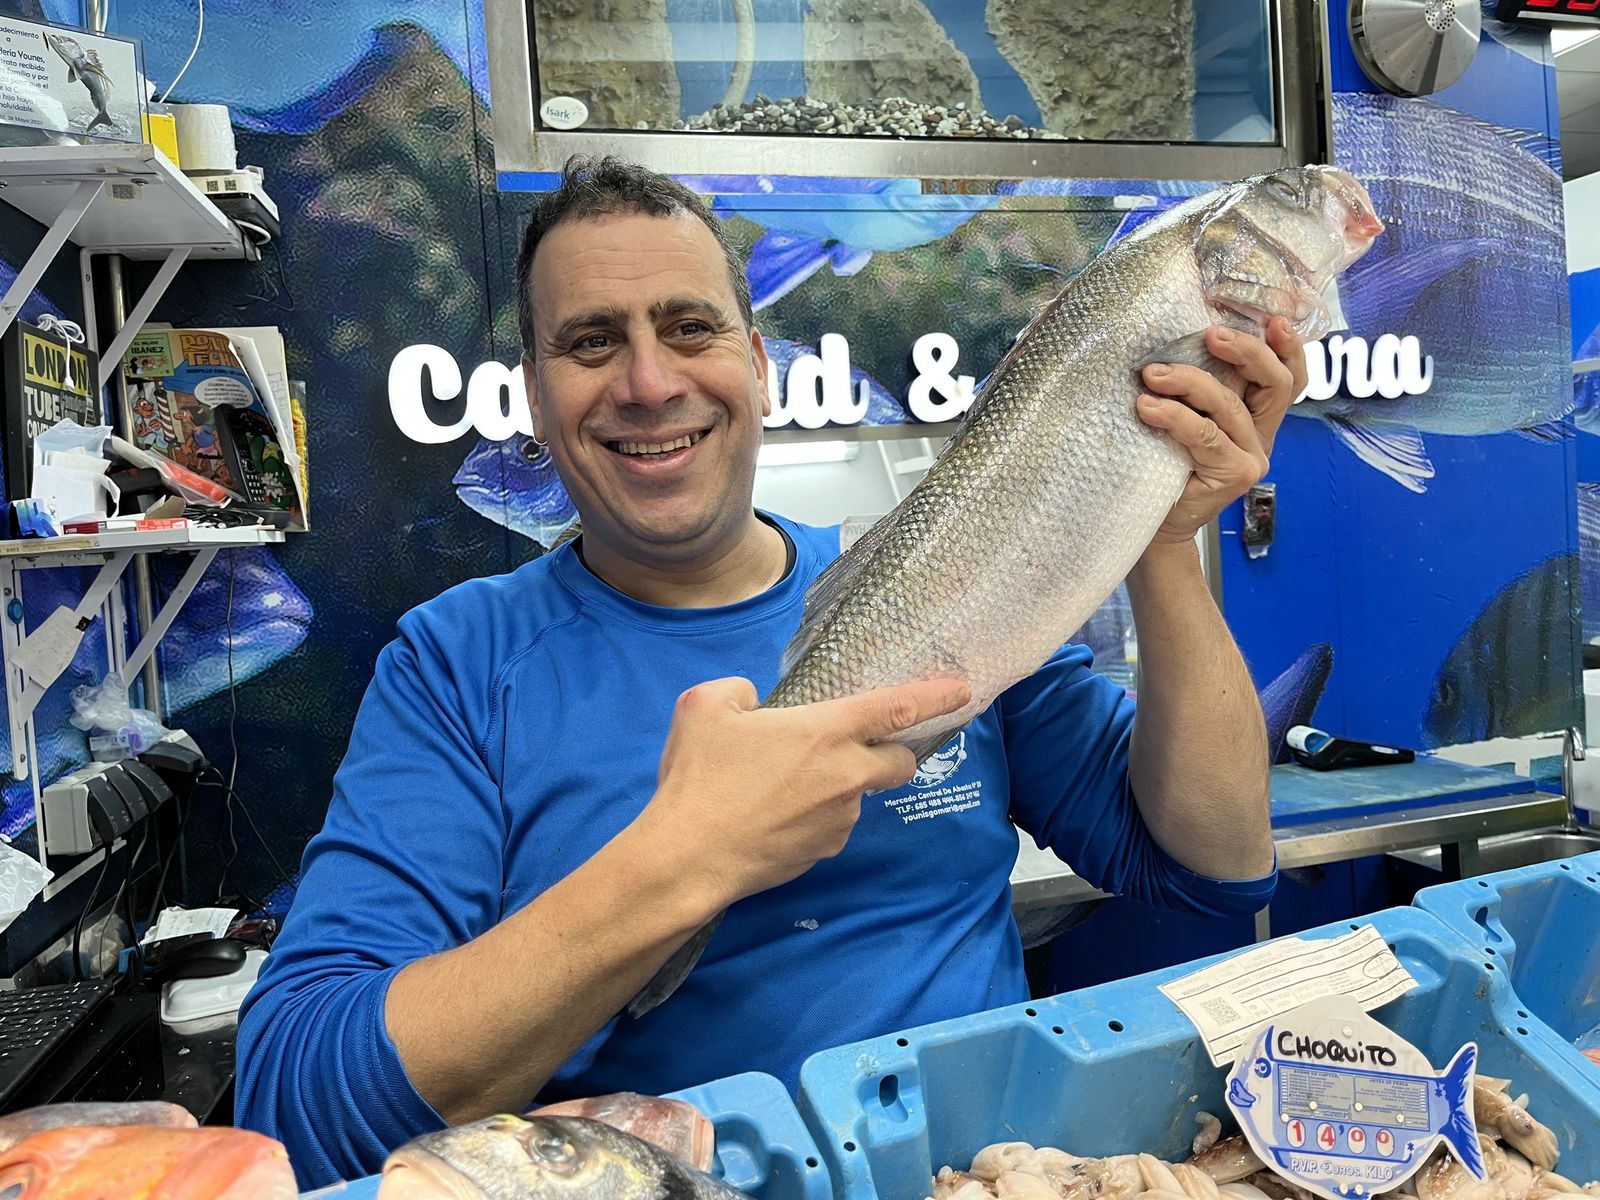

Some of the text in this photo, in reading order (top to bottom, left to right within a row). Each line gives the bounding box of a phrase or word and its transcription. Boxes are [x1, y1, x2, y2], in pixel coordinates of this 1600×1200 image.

[19, 62, 45, 71] recibido
[24, 338, 88, 392] LONDON
[908, 332, 977, 422] &
[24, 385, 61, 422] TUBE
[884, 795, 917, 808] Mercado
[917, 789, 943, 800] Central
[896, 805, 914, 814] TLF:
[1366, 1165, 1394, 1180] KILO
